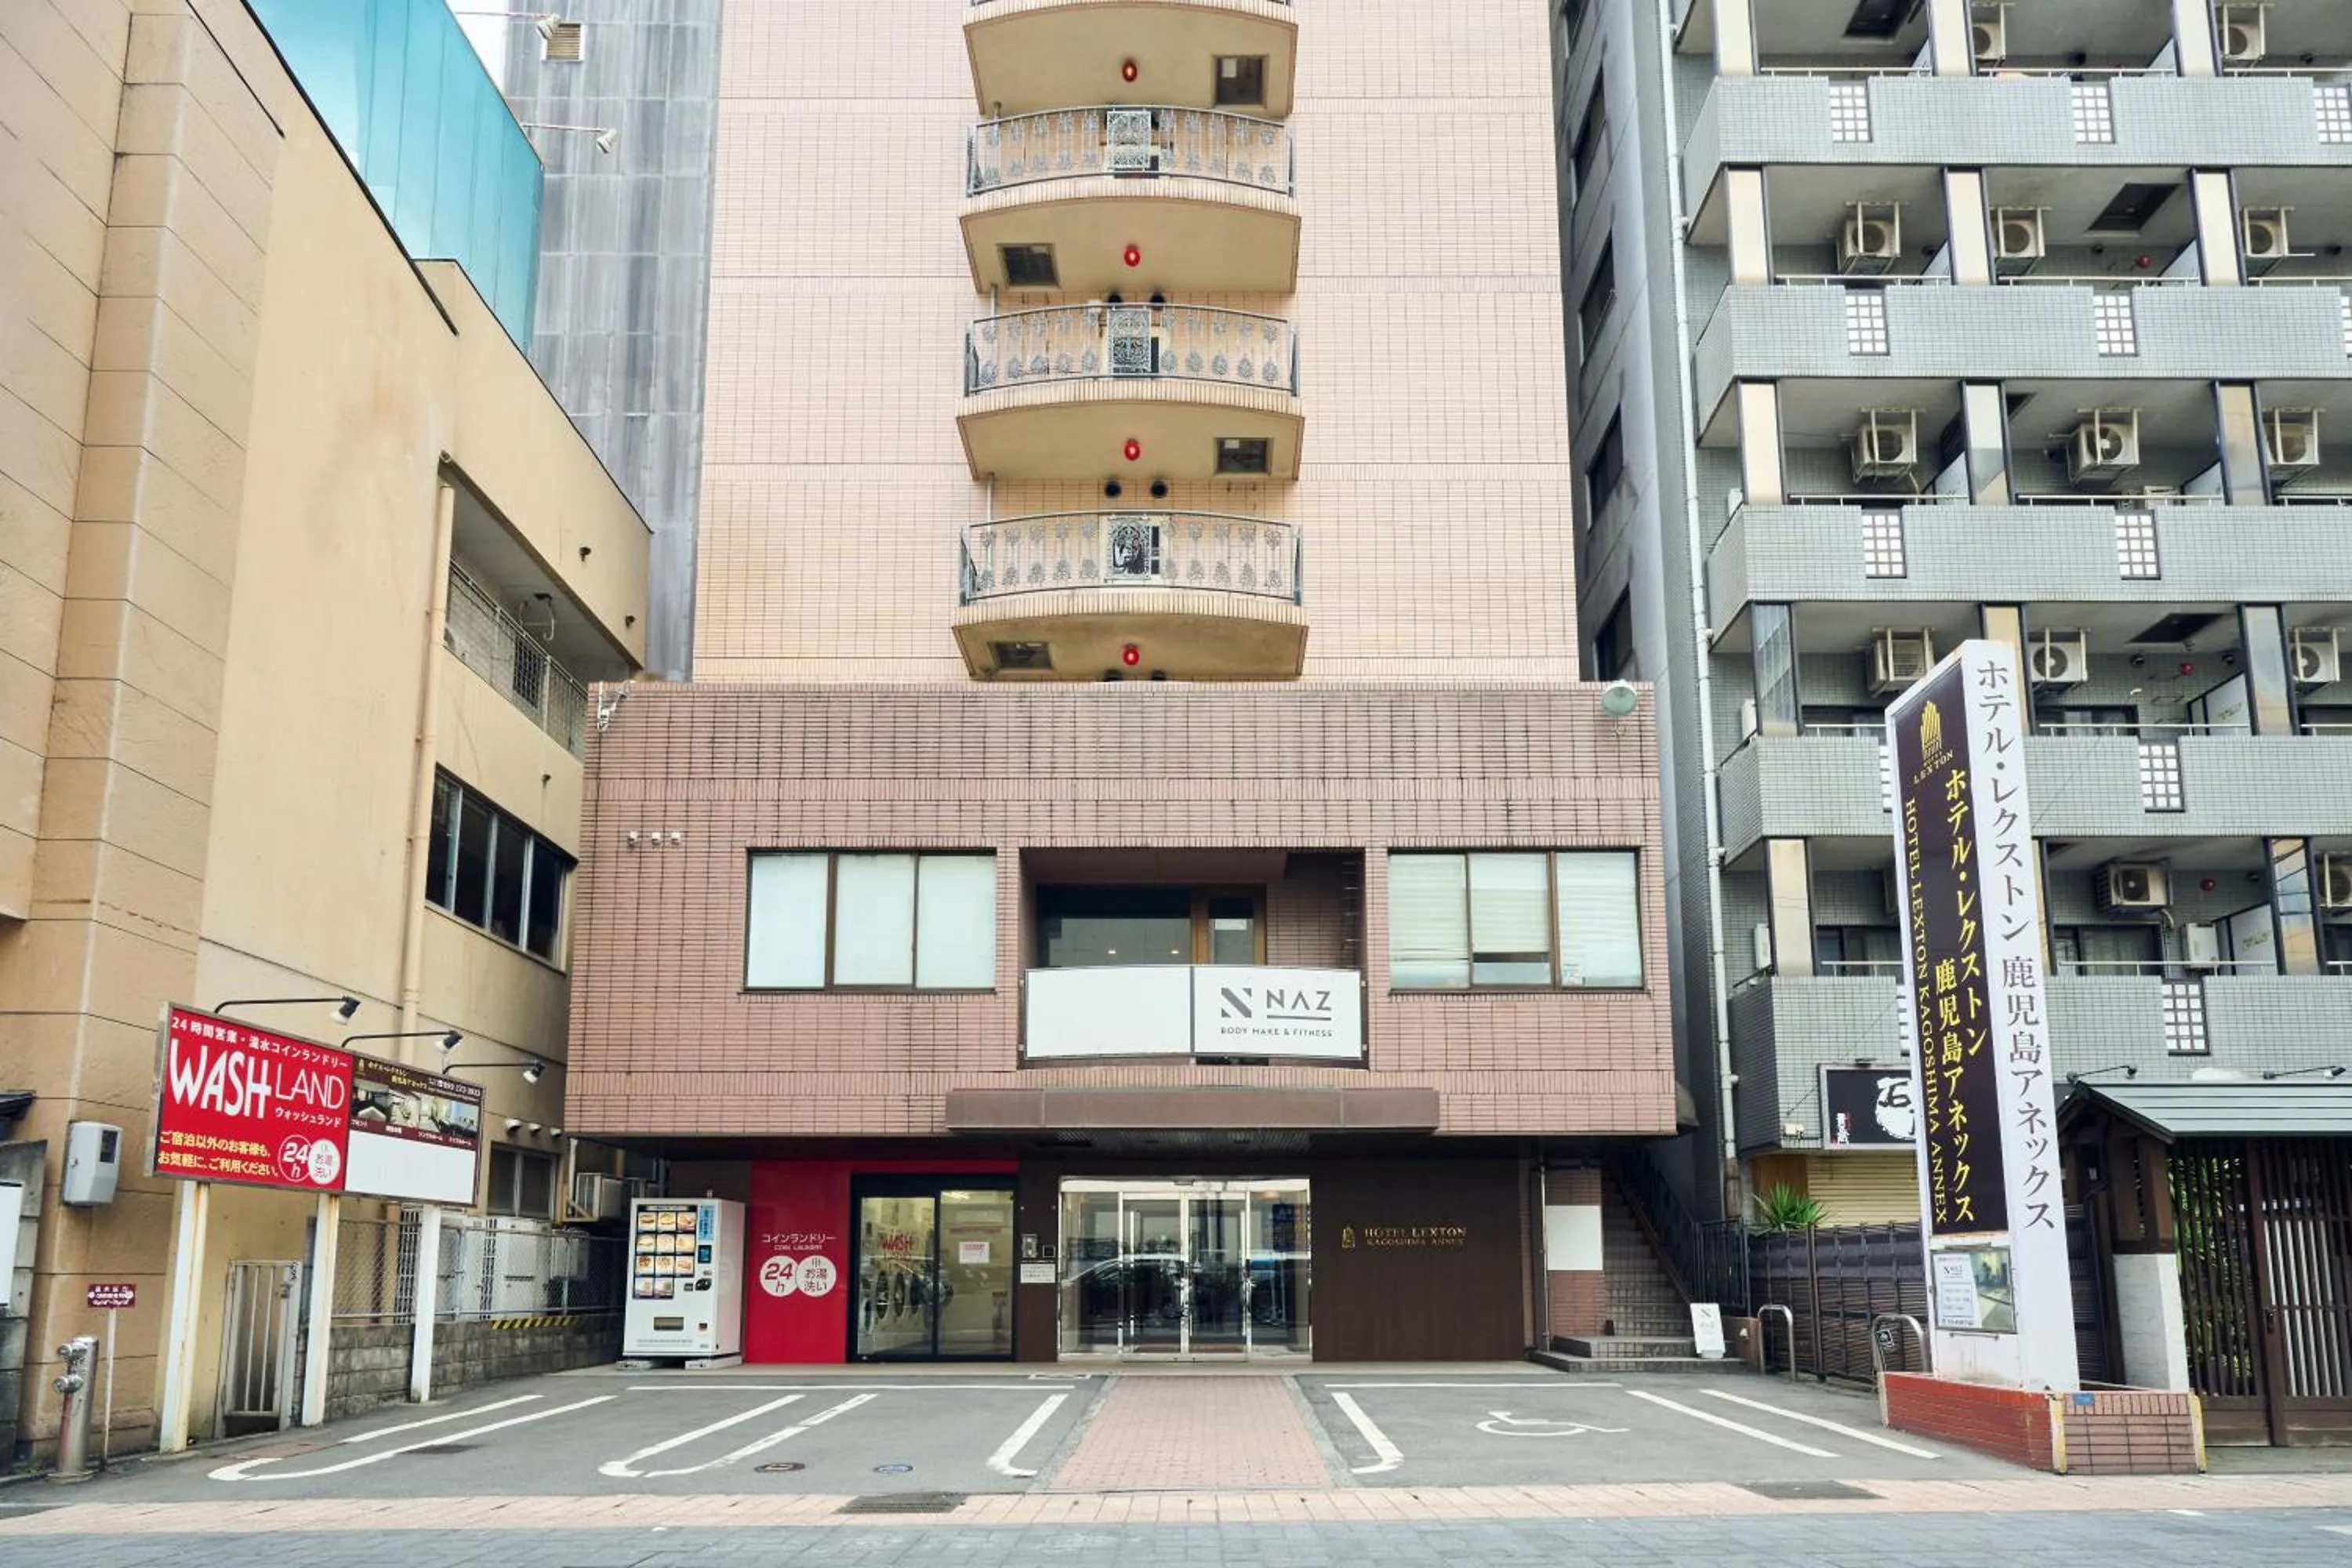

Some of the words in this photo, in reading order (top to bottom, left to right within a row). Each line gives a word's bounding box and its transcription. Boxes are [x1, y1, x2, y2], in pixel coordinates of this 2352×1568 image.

[1914, 749, 1954, 785] LEXTON
[1976, 659, 2031, 942] ホテル・レクストン
[1905, 797, 1921, 879] HOTEL
[1911, 881, 1929, 979] LEXTON
[1945, 769, 1988, 1056] ホテル・レクストン
[1221, 1026, 1248, 1035] BODY
[1252, 1027, 1280, 1036] MAKE
[1293, 1028, 1333, 1037] FITNESS
[1266, 989, 1332, 1011] NAZ
[170, 1037, 272, 1120] WASH
[275, 1062, 346, 1110] LAND
[1918, 985, 1940, 1134] KAGOSHIMA
[1935, 957, 1975, 1223] 鹿児島アネックス
[2002, 956, 2055, 1229] 鹿児島アネックス
[275, 1106, 343, 1127] ウォッシュランド
[282, 1142, 309, 1164] 24
[1931, 1142, 1947, 1223] ANNEX
[761, 1232, 837, 1244] コインランドリー
[764, 1262, 793, 1280] 24
[1364, 1228, 1410, 1238] HOTEL
[1412, 1226, 1468, 1237] LEXTON
